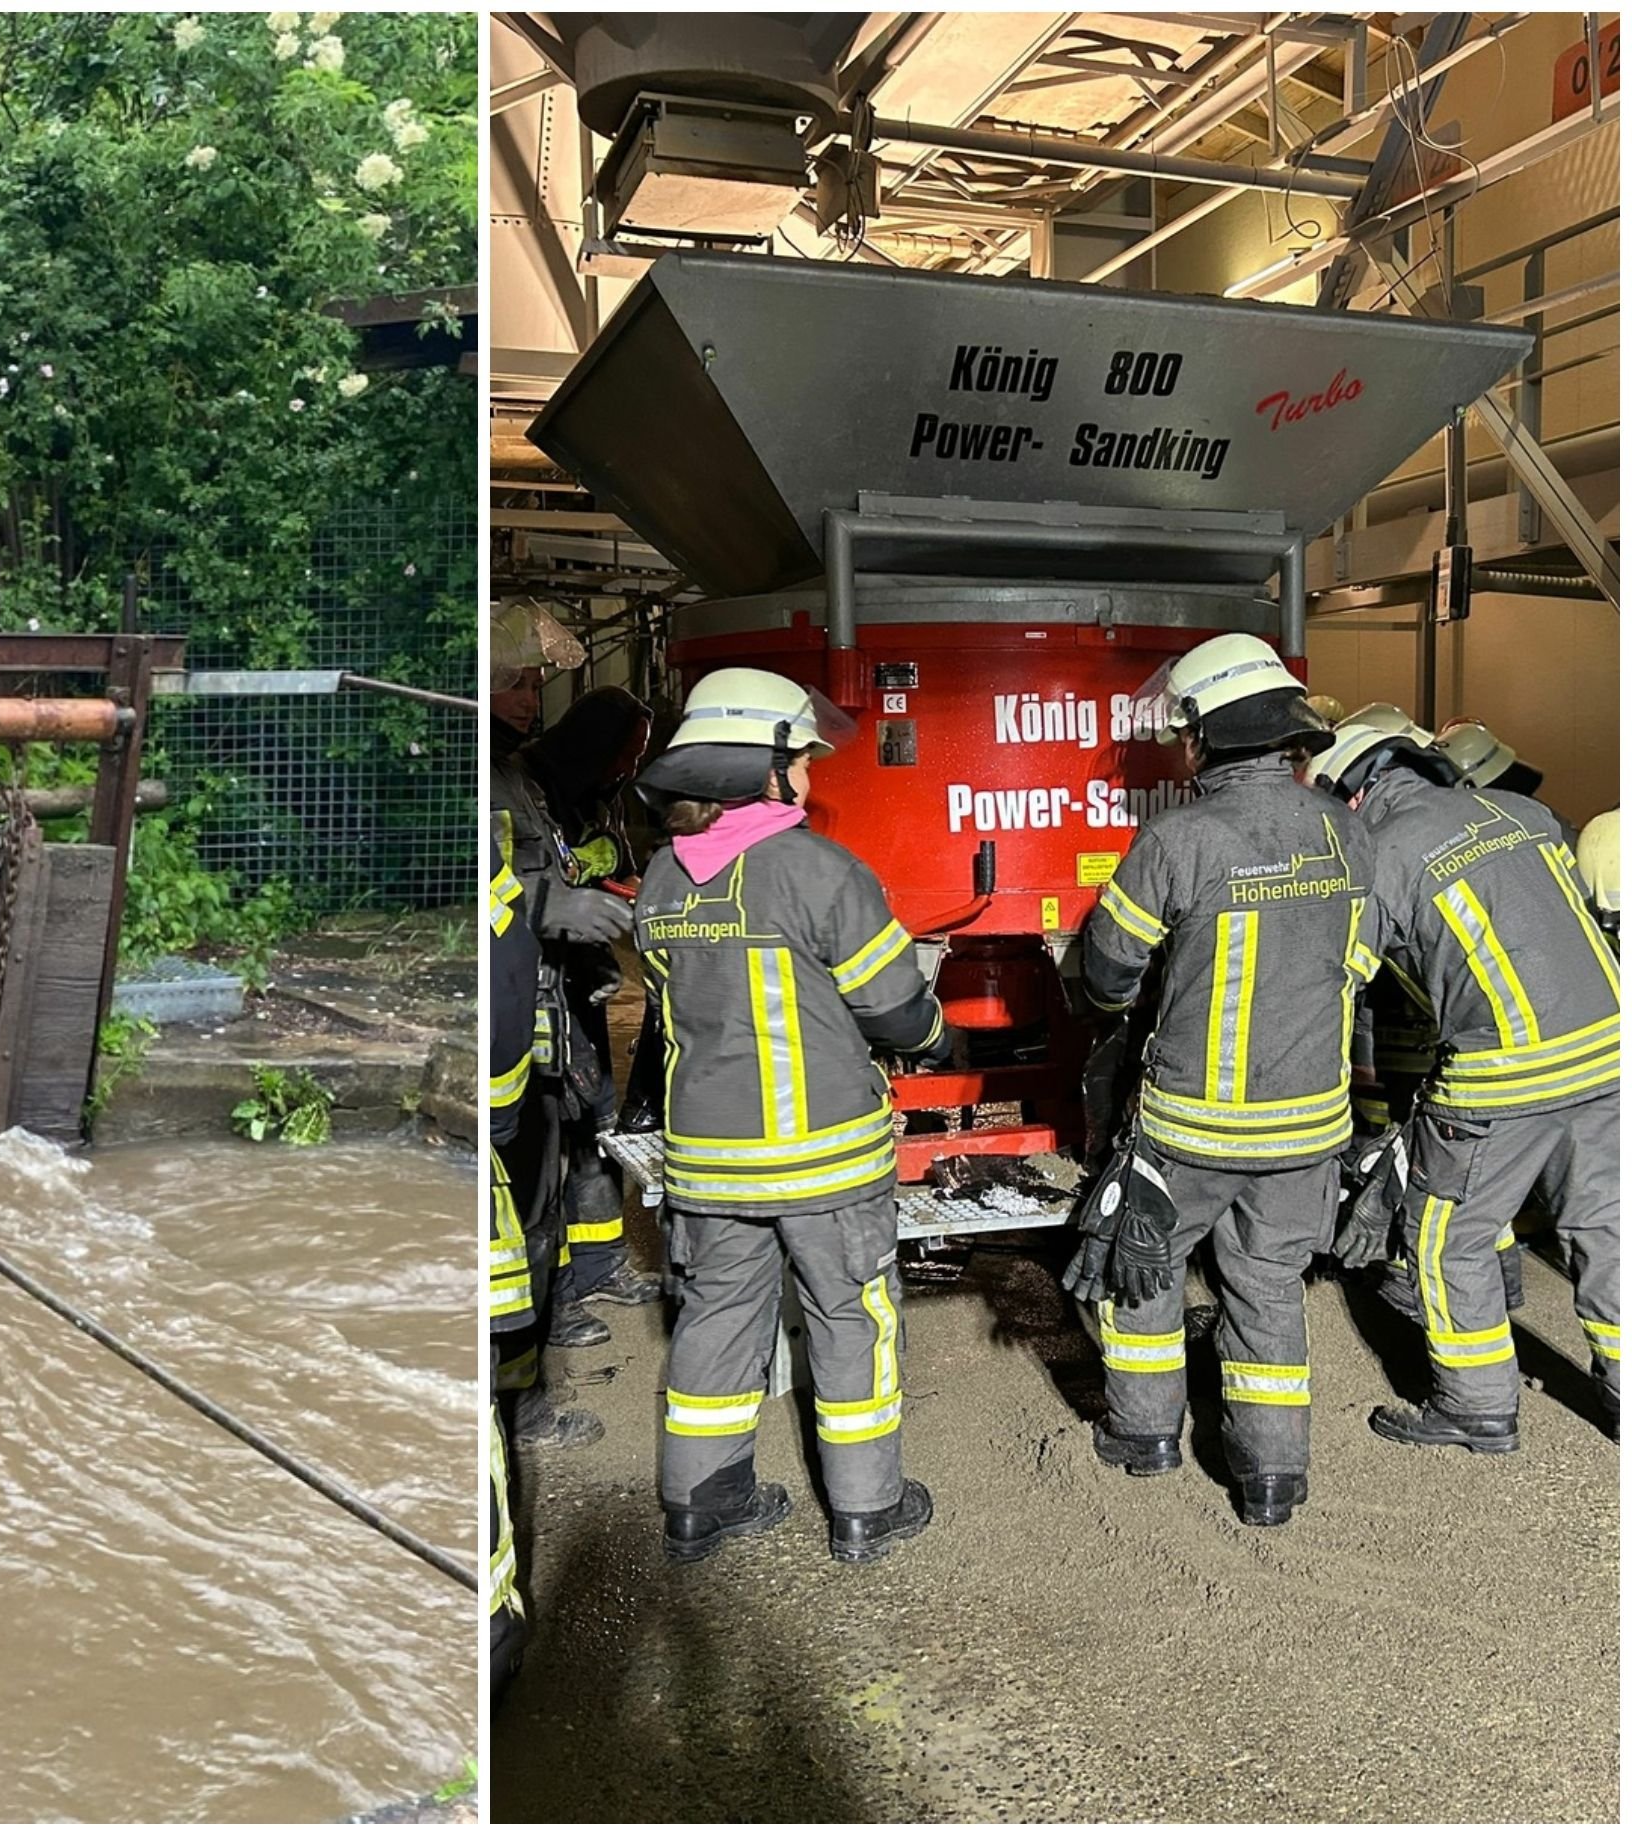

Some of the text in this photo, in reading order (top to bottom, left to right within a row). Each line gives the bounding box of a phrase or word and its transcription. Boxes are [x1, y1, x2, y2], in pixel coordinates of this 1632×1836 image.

[949, 345, 1184, 402] König 800
[1255, 367, 1364, 431] Turbo
[909, 413, 1231, 480] Power- Sandking
[886, 696, 904, 711] CE
[994, 692, 1099, 749] König
[1230, 860, 1291, 879] Feuerwehr
[1430, 829, 1529, 882] Hohentengen
[1232, 877, 1347, 904] Hohentengen
[647, 920, 741, 943] Hohentengen
